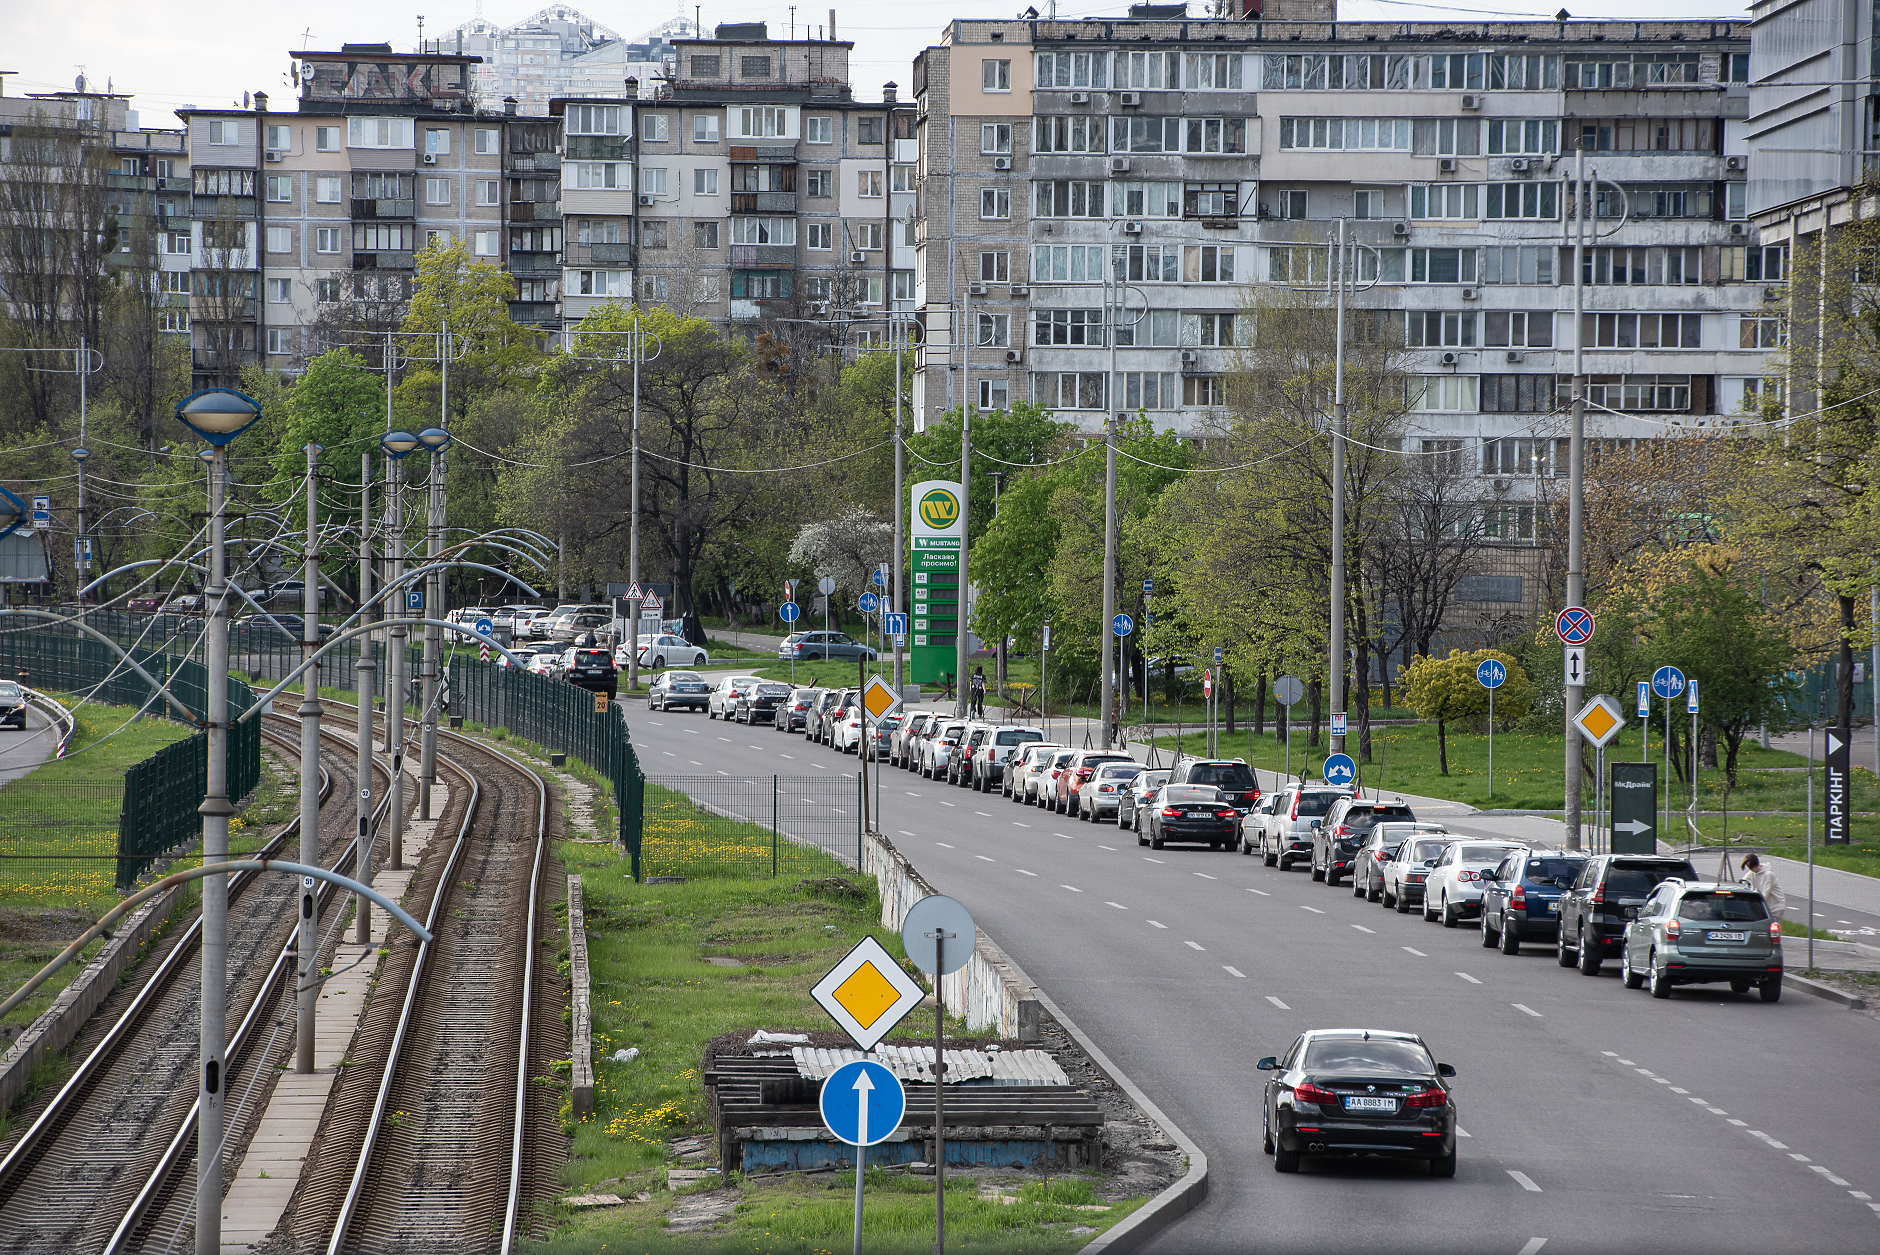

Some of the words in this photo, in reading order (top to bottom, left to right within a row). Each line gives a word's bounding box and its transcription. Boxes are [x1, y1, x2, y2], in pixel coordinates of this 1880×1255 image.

[410, 594, 419, 606] P
[1830, 767, 1843, 839] ПАРКІНГ
[1351, 1098, 1361, 1106] AA
